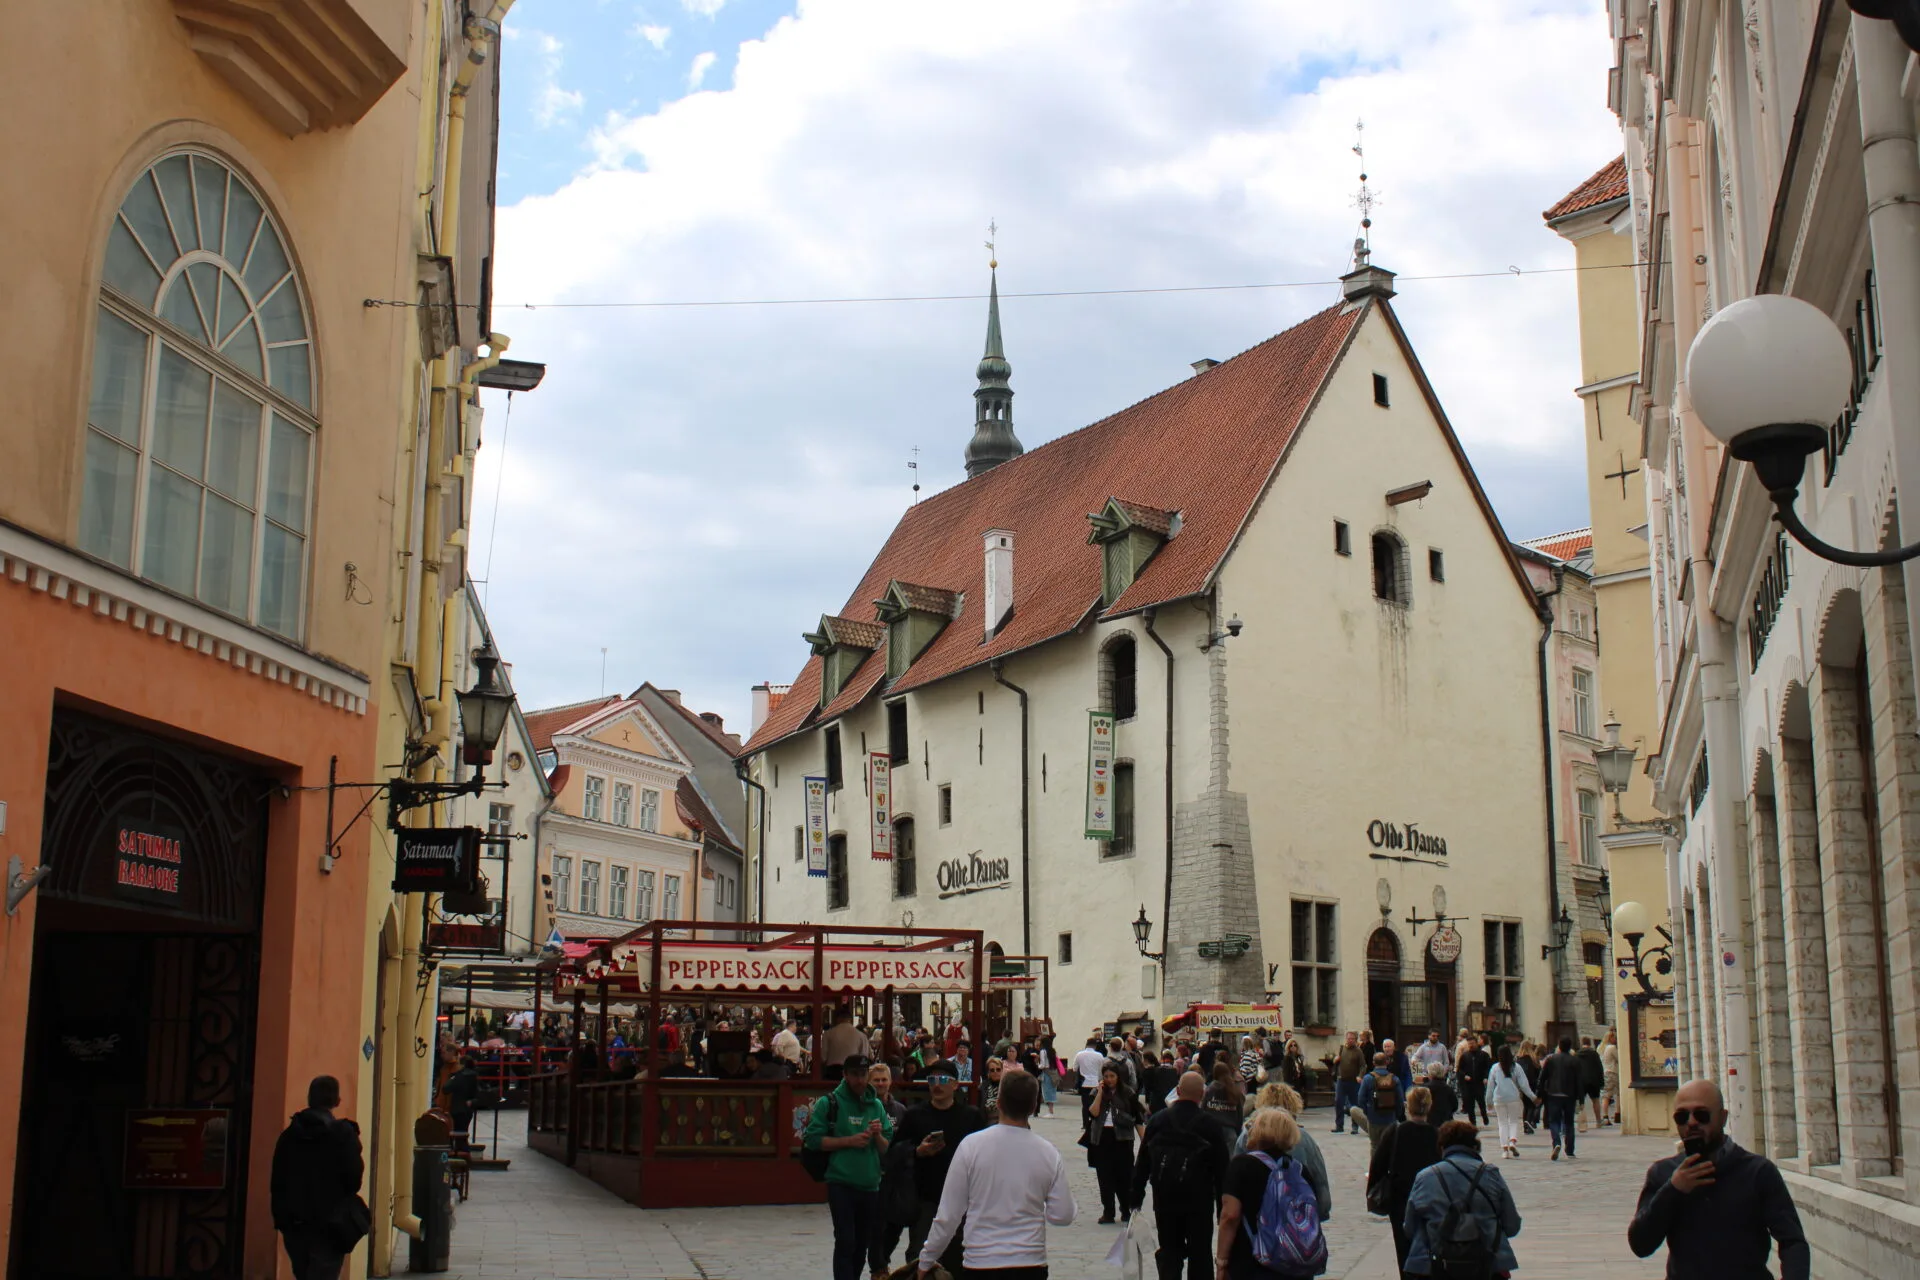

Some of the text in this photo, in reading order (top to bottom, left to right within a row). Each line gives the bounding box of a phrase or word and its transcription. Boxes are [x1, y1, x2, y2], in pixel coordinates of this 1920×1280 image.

[118, 828, 181, 864] SATUMAA
[403, 840, 454, 860] Satumaa
[1366, 819, 1447, 856] Olde Hansa
[118, 859, 180, 893] KARAOKE
[936, 849, 1009, 891] Olde Hansa
[668, 960, 966, 979] PEPPERSACK PEPPERSACK
[1210, 1014, 1232, 1026] Olde
